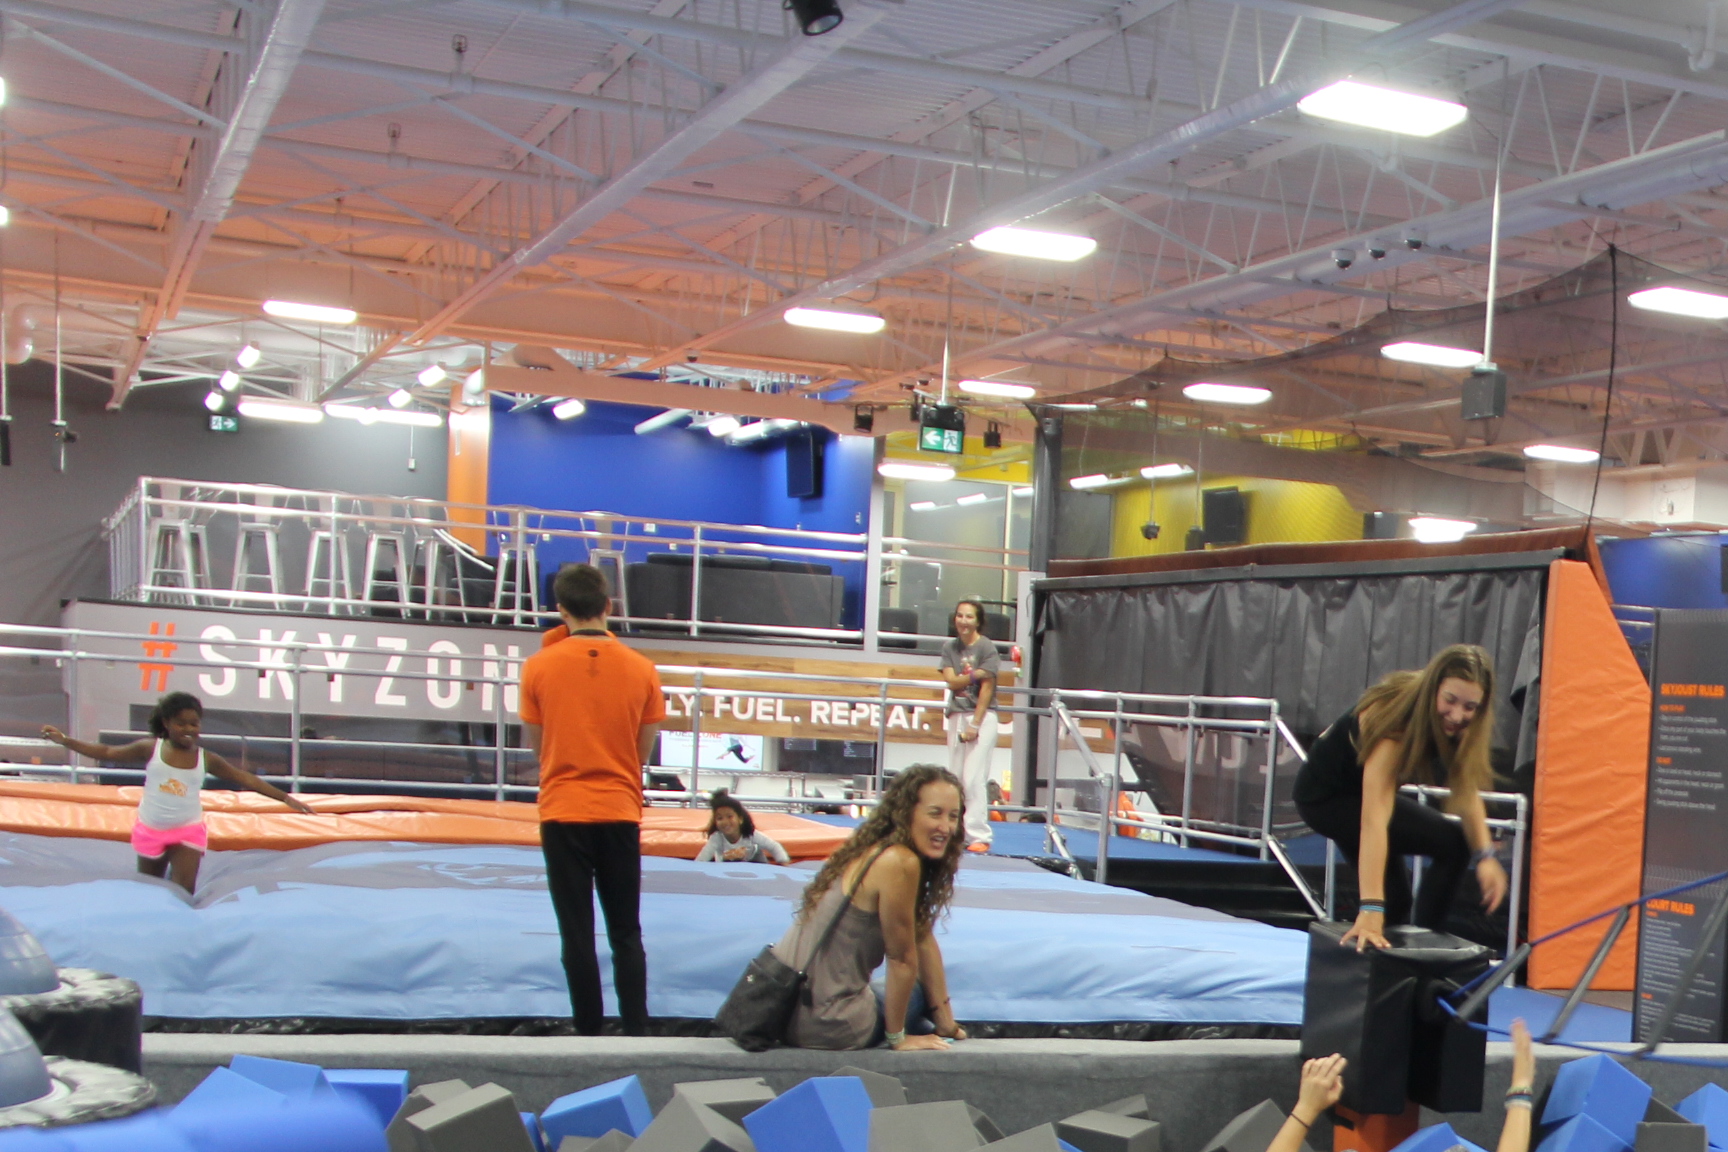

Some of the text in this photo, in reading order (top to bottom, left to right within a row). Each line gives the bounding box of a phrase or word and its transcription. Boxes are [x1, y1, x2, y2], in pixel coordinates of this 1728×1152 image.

[1699, 684, 1725, 697] RULES
[714, 696, 800, 722] FUEL.
[810, 700, 930, 730] REPEAT.
[1670, 902, 1695, 915] RULES
